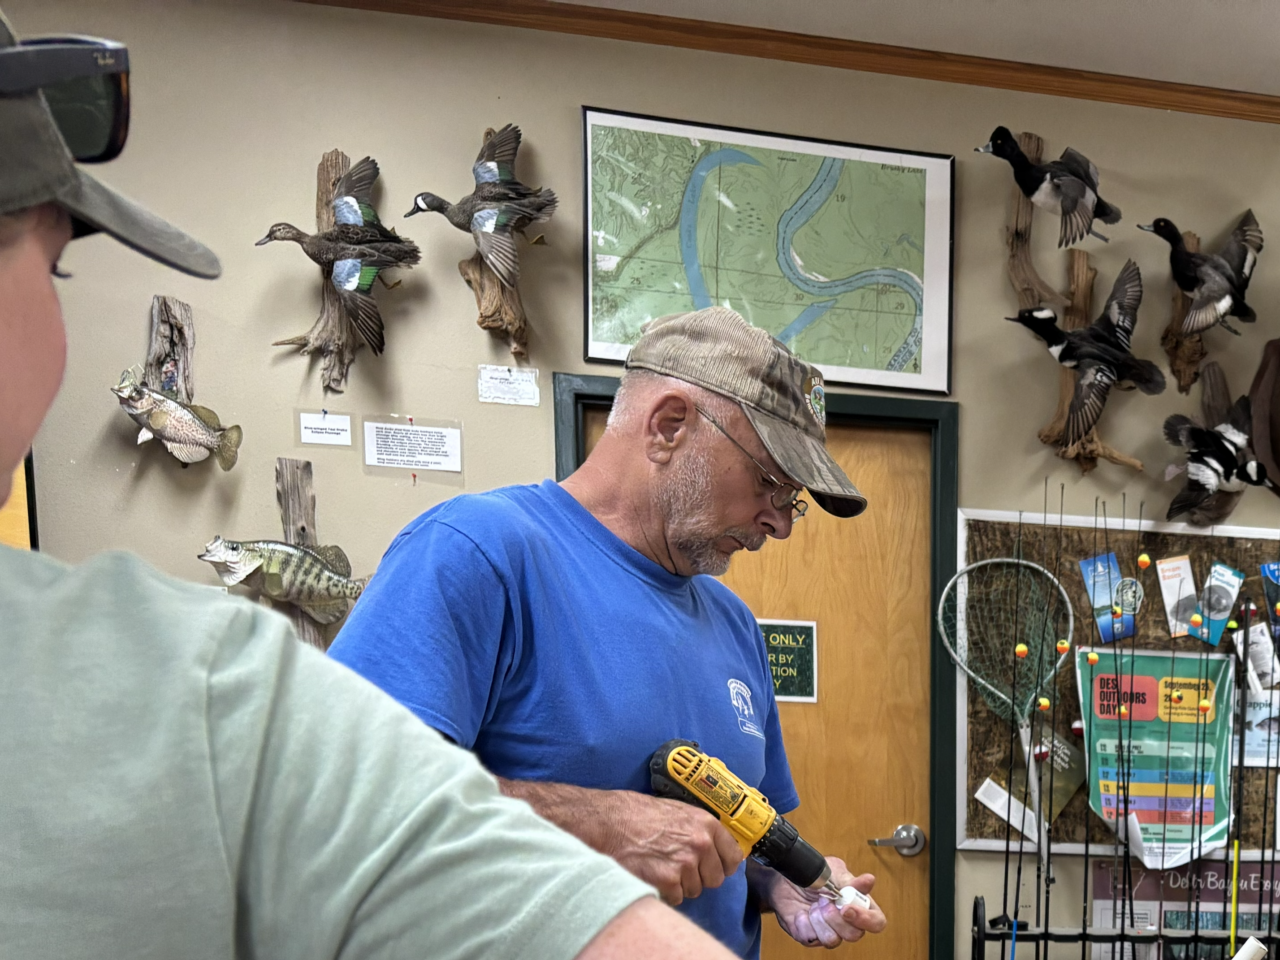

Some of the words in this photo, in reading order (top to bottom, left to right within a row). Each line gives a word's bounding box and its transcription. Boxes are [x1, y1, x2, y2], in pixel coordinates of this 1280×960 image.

[769, 633, 806, 646] ONLY
[779, 654, 794, 664] BY
[1099, 703, 1117, 716] DAY
[1236, 700, 1273, 711] Cappie
[1168, 870, 1203, 889] Det
[1204, 871, 1248, 896] Bayu
